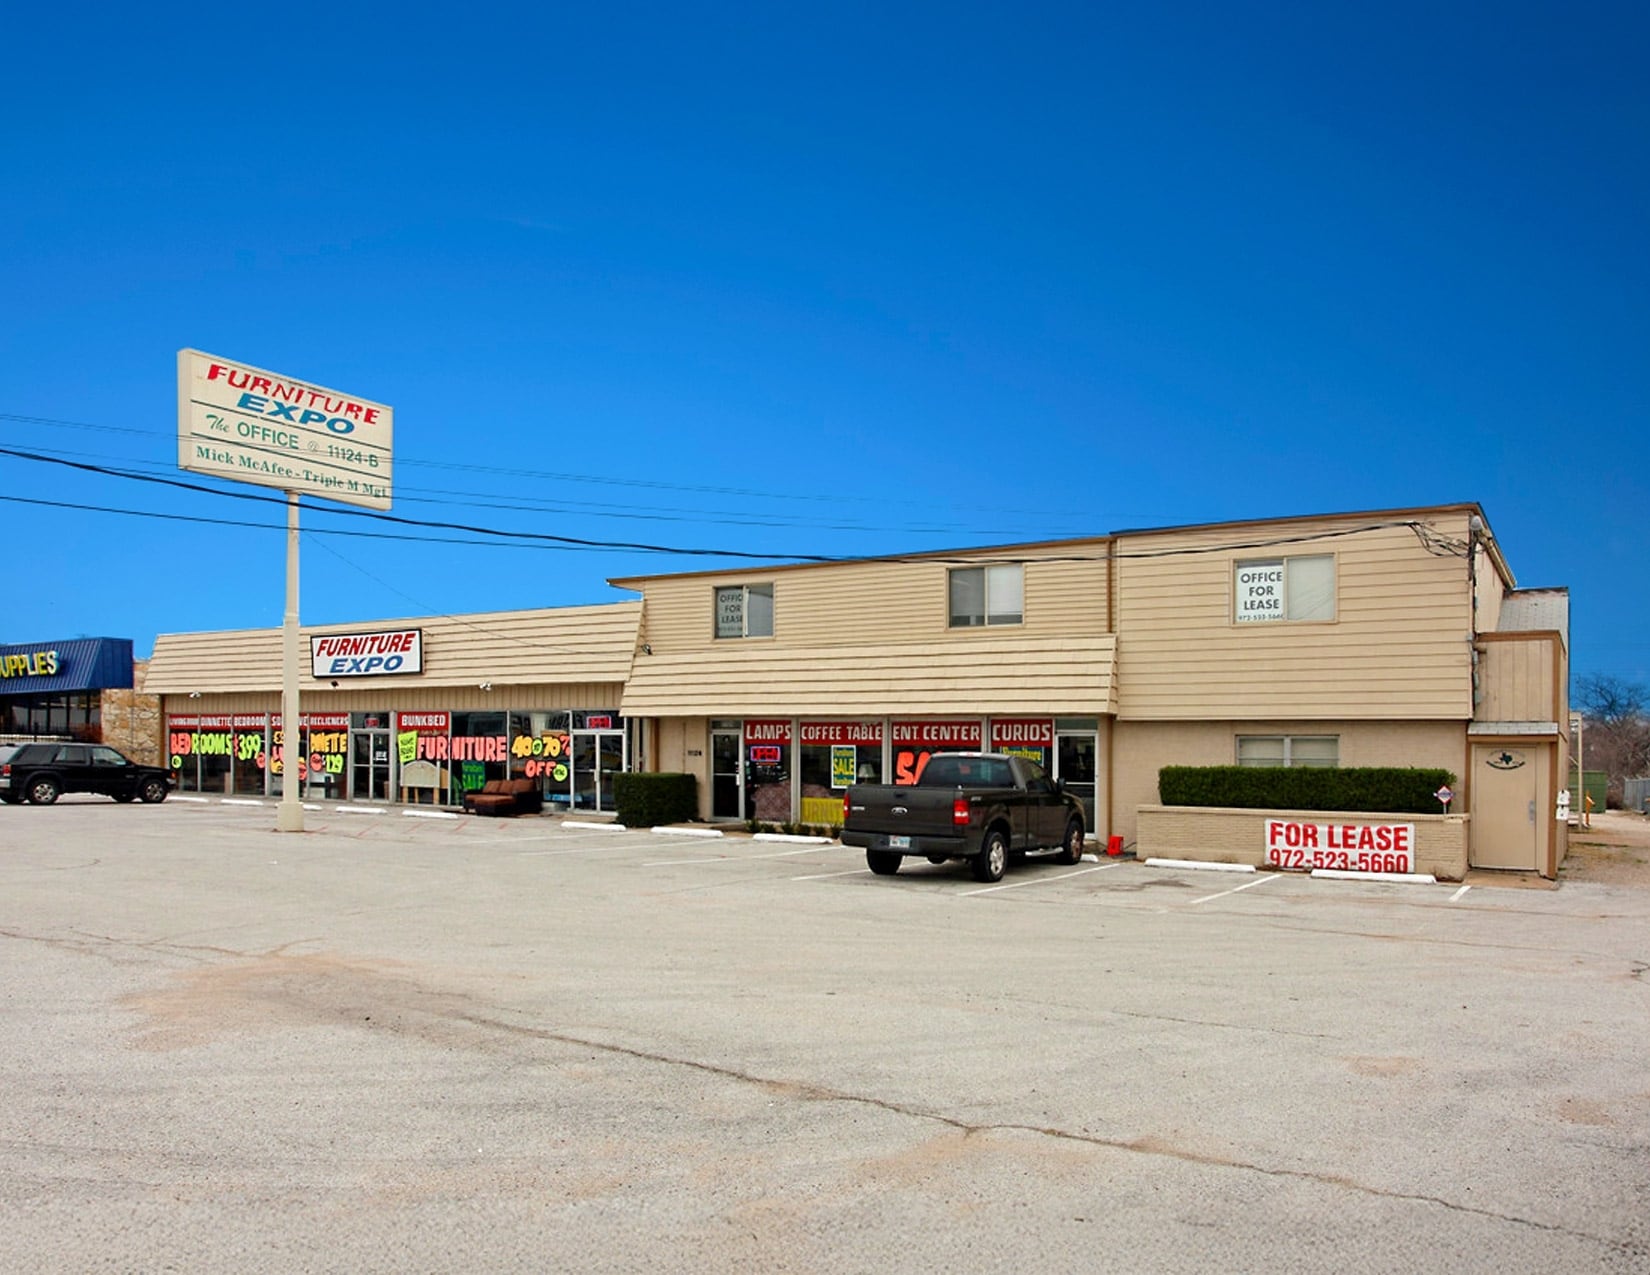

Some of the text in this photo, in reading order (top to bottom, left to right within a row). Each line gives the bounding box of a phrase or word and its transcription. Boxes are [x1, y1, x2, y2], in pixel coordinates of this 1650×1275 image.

[207, 363, 381, 425] FURNITURE
[236, 392, 355, 435] EXPO
[205, 413, 230, 433] The
[237, 421, 300, 450] OFFICE
[327, 444, 379, 468] 11124-B
[196, 445, 235, 465] Mick
[238, 454, 293, 478] McAfee
[302, 469, 344, 489] Triple
[347, 479, 359, 493] M
[362, 482, 387, 499] Mgt
[1240, 571, 1283, 584] OFFICE
[720, 593, 743, 603] OFFIC
[1248, 585, 1274, 597] FOR
[724, 604, 742, 613] FOR
[1243, 598, 1280, 611] LEASE
[316, 632, 417, 657] FURNITURE
[0, 651, 58, 676] UPPLIES
[329, 655, 404, 674] EXPO
[746, 724, 792, 740] LAMPS
[801, 725, 882, 740] COFFEE TABLE
[923, 724, 980, 741] CENTER
[992, 723, 1051, 742] CURIOS
[416, 735, 508, 762] FURNITURE
[524, 759, 557, 778] OFF
[832, 757, 855, 776] SALE
[1270, 821, 1409, 851] FOR LEASE
[1269, 848, 1409, 873] 972-523-5660
